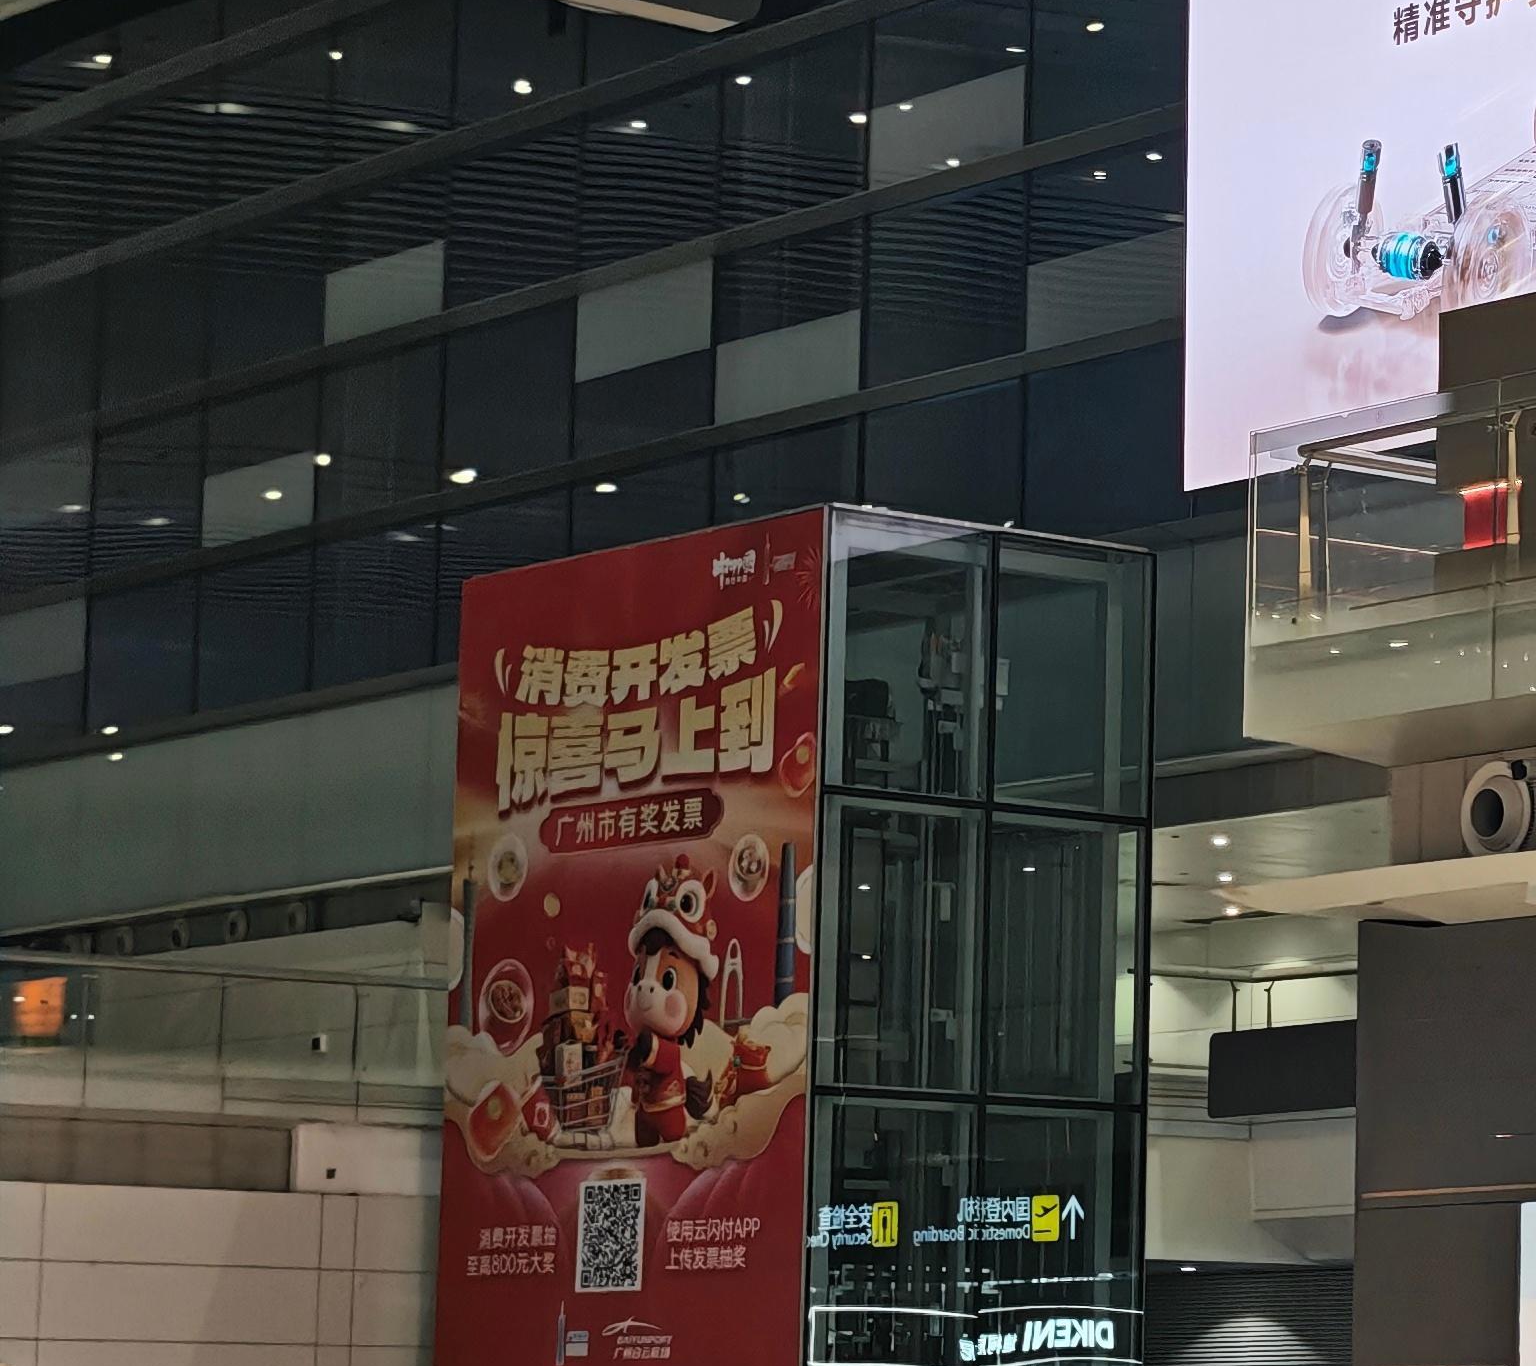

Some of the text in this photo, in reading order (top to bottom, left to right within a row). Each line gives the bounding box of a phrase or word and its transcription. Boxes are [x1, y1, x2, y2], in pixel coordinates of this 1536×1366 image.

[514, 605, 758, 707] 消费开发票
[496, 667, 777, 813] 惊喜马上到
[555, 796, 705, 848] 广州市有奖发票
[666, 1216, 761, 1243] 使用云闪付APP
[664, 1244, 747, 1271] 上传发票抽奖
